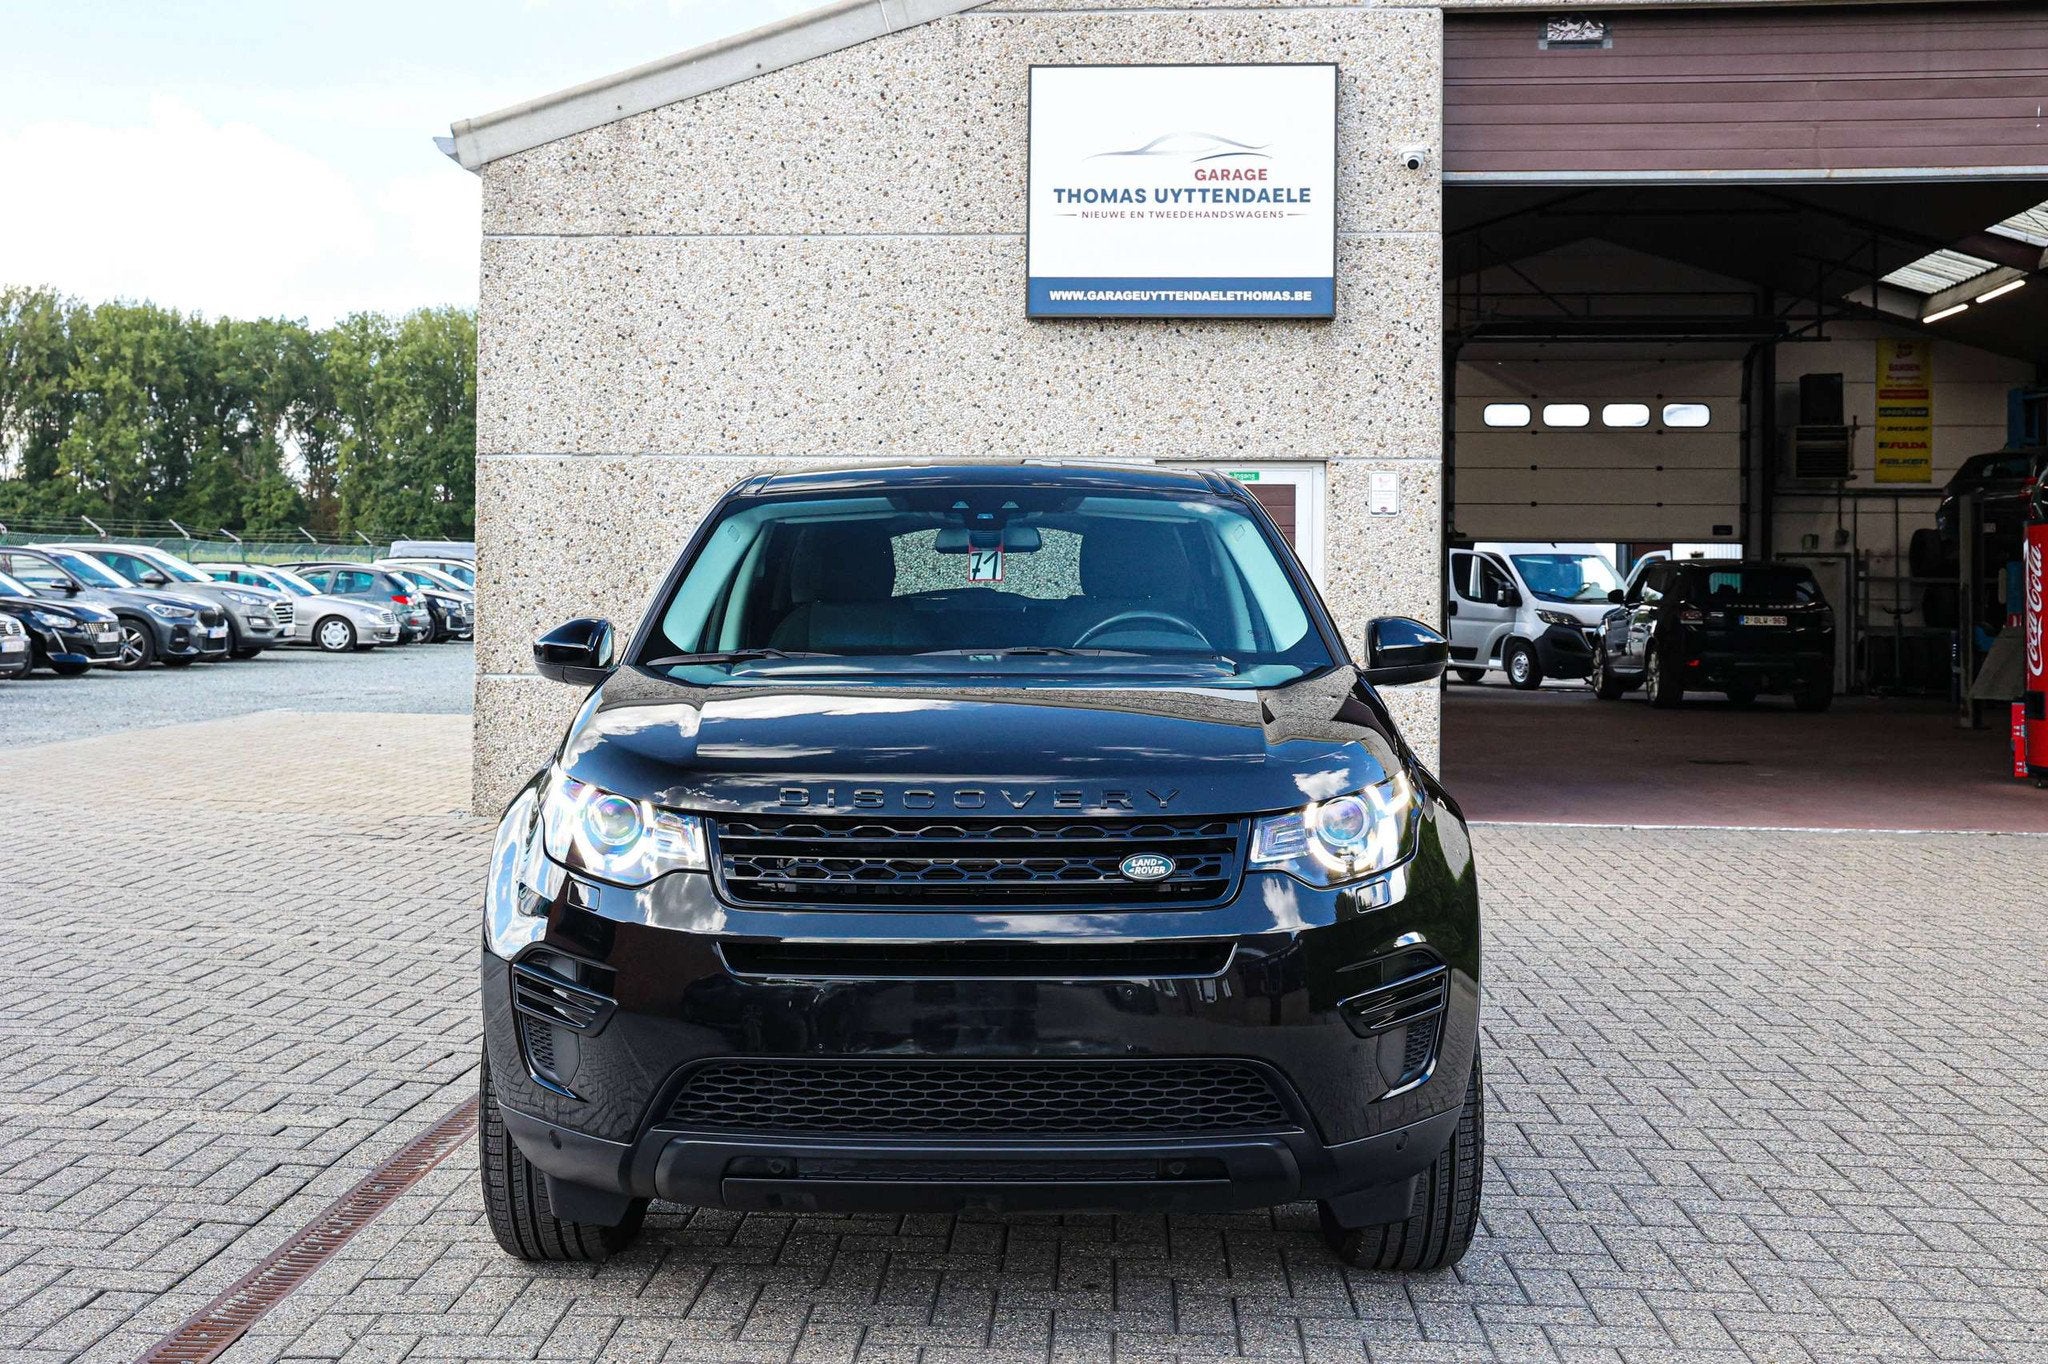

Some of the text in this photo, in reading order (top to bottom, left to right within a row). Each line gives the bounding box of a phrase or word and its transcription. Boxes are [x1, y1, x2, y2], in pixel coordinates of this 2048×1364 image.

[1194, 168, 1268, 181] GARAGE
[1053, 187, 1311, 203] THOMAS UYTTENDAELE
[1081, 210, 1285, 219] NIEUWE EN TWEEDEHANDSWAGENS
[1049, 289, 1312, 302] WWW.GARAGEUYTTENDAELETHOMAS.BE
[1887, 441, 1928, 449] FULDA
[778, 787, 1181, 809] DISCOVERY
[1131, 858, 1157, 867] LAND
[1134, 866, 1166, 875] ROVER
